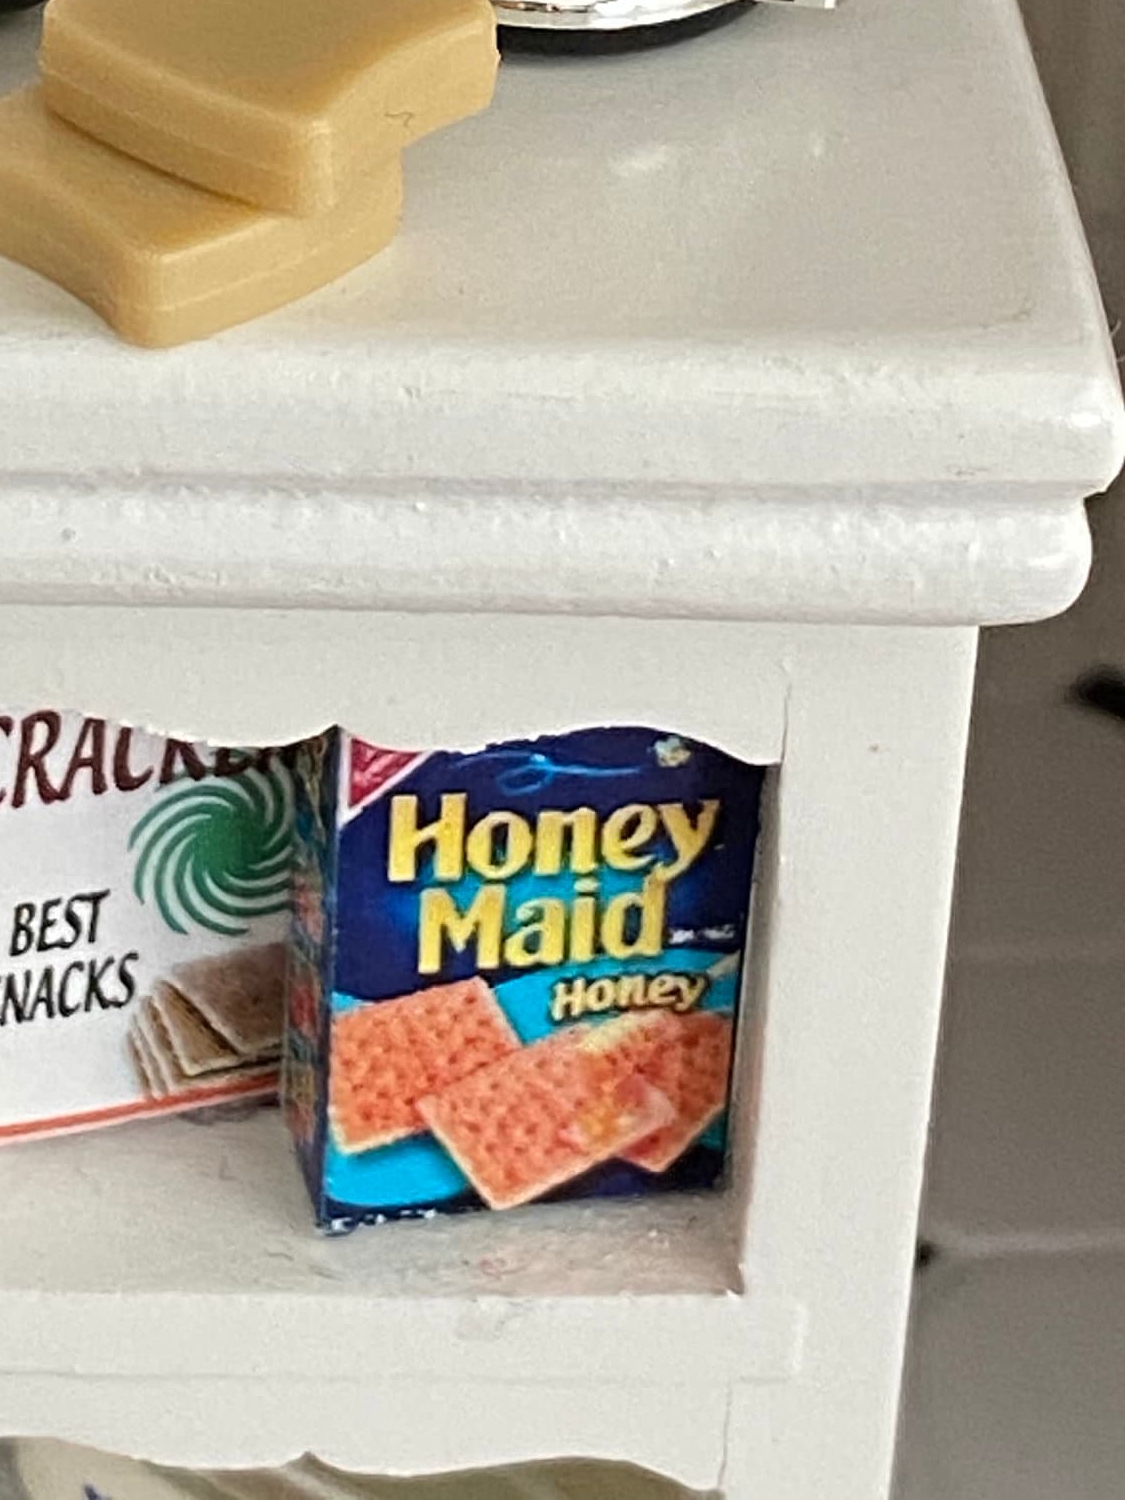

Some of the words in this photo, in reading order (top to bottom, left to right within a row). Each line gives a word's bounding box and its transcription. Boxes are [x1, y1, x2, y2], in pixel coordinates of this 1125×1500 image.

[387, 792, 721, 883] Honey
[8, 889, 110, 957] BEST
[417, 866, 667, 974] Maid
[551, 972, 707, 1021] Honey
